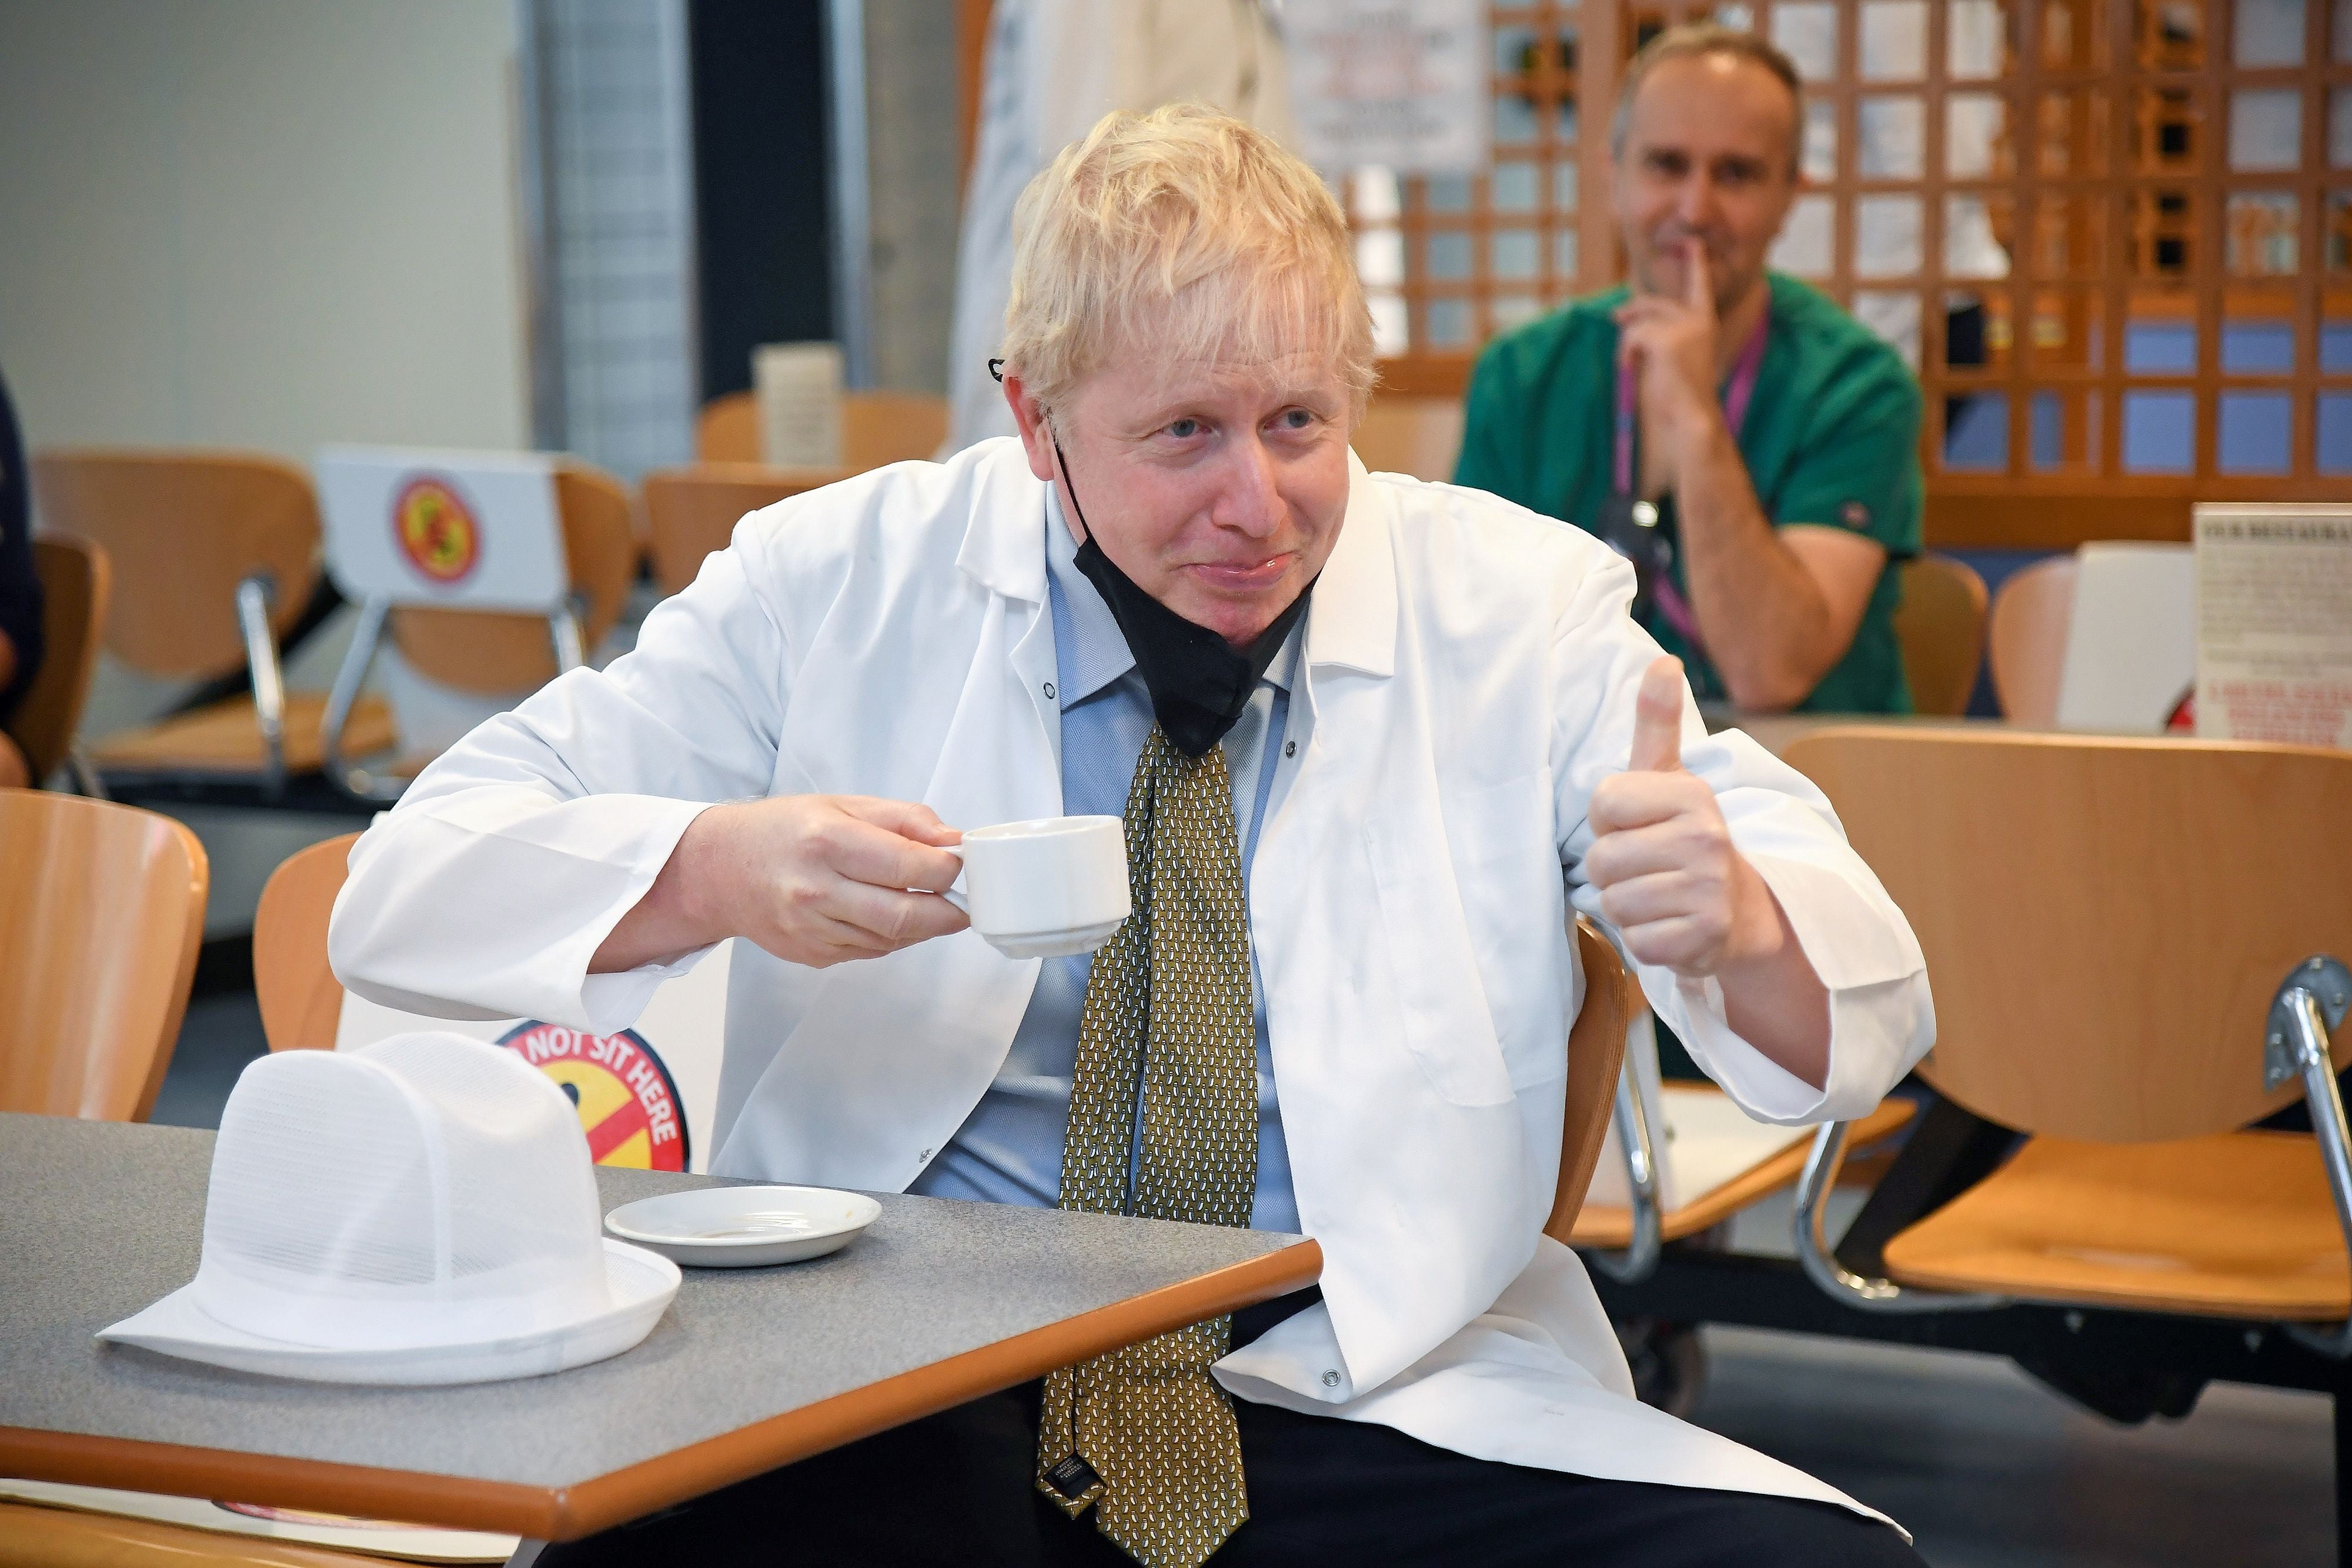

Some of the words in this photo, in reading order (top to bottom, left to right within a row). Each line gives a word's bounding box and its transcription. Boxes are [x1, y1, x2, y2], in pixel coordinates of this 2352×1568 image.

[526, 1028, 583, 1063] NOT
[589, 1037, 634, 1071] SIT
[626, 1060, 676, 1146] HERE
